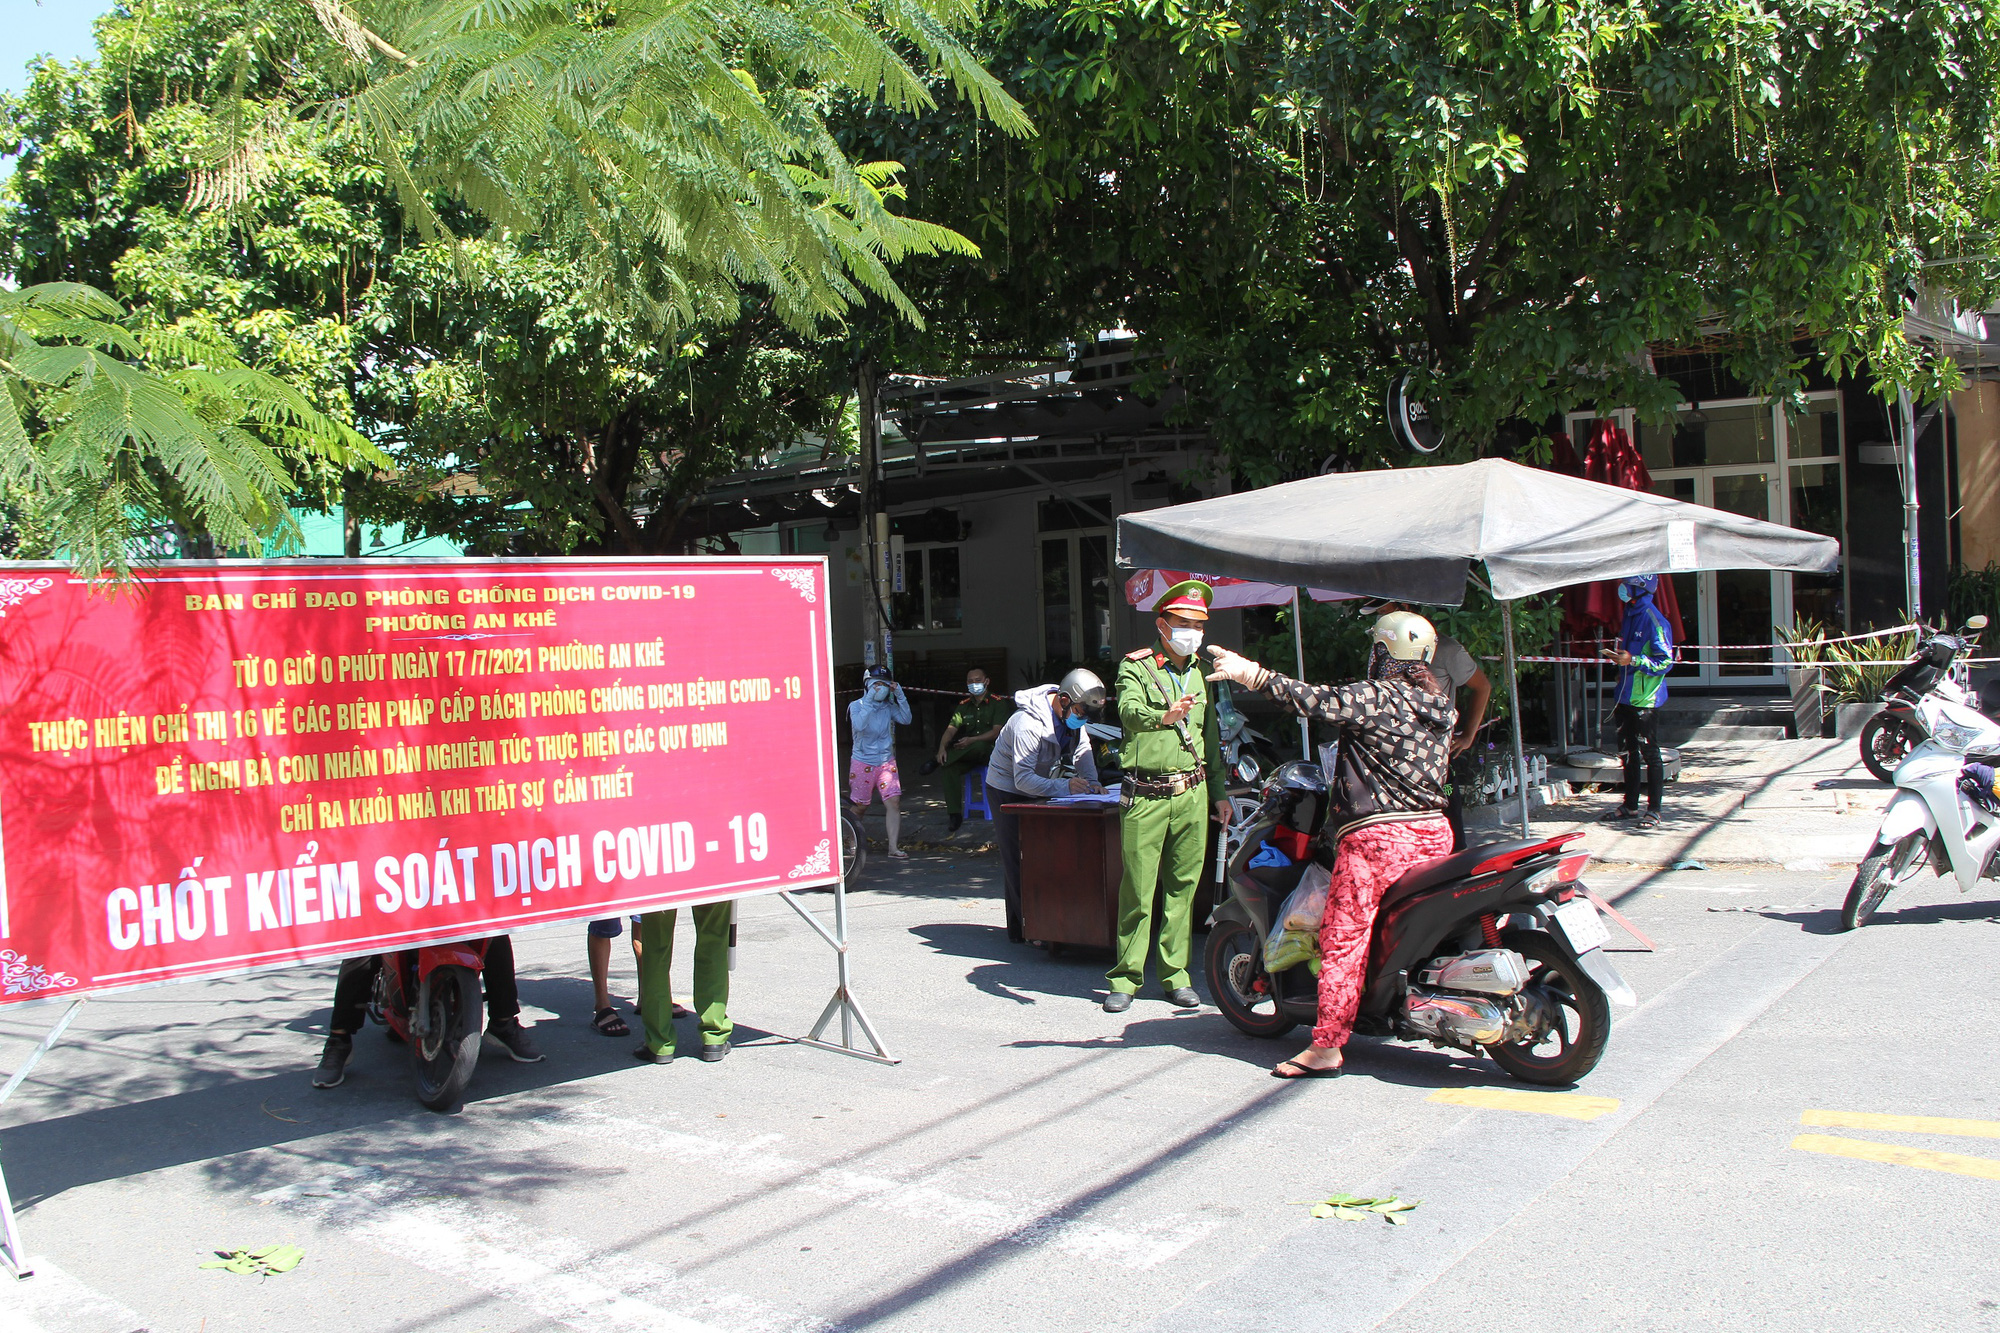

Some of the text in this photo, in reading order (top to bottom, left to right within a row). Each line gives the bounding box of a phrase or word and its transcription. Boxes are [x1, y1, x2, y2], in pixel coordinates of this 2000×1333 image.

[186, 583, 695, 610] BAN CHỈ ĐẠO PHÒNG CHỐNG DỊCH COVID-19
[365, 609, 558, 632] PHƯỜNG AN KHÊ
[233, 654, 259, 688] TỪ
[283, 650, 316, 686] GIỜ
[338, 648, 386, 682] PHÚT
[391, 646, 439, 680] NGÀY
[445, 650, 466, 676] 17
[538, 639, 605, 672] PHƯỜNG
[609, 643, 631, 668] AN
[634, 637, 665, 667] KHÊ
[29, 717, 88, 758] THỰC
[95, 711, 147, 753] HIỆN
[153, 704, 189, 744] CHỈ
[194, 712, 227, 745] THỊ
[233, 710, 257, 738] 16
[261, 698, 287, 736] VỀ
[292, 696, 331, 734] CÁC
[337, 697, 381, 735] BIỆN
[386, 693, 434, 728] PHÁP
[440, 687, 475, 723] CẤP
[481, 684, 526, 721] BÁCH
[530, 684, 586, 717] PHÒNG
[591, 678, 644, 713] CHỐNG
[648, 683, 684, 714] DỊCH
[687, 677, 726, 711] BỆNH
[730, 678, 771, 703] COVID
[784, 676, 801, 699] 19
[156, 722, 727, 796] ĐỀ NGHỊ BÀ CON NHÂN DÂN NGHIÊM TÚC THỰC HIỆN CÁC QUY ĐỊNH
[279, 764, 633, 834] CHỈ RA KHỎI NHÀ KHI THẬT SỰ CẦN THIẾT
[106, 855, 232, 950] CHỐT
[246, 839, 361, 932] KIỂM
[374, 838, 478, 913] SOÁT
[491, 834, 582, 906] DỊCH
[593, 821, 695, 883] COVID
[729, 812, 768, 863] 19
